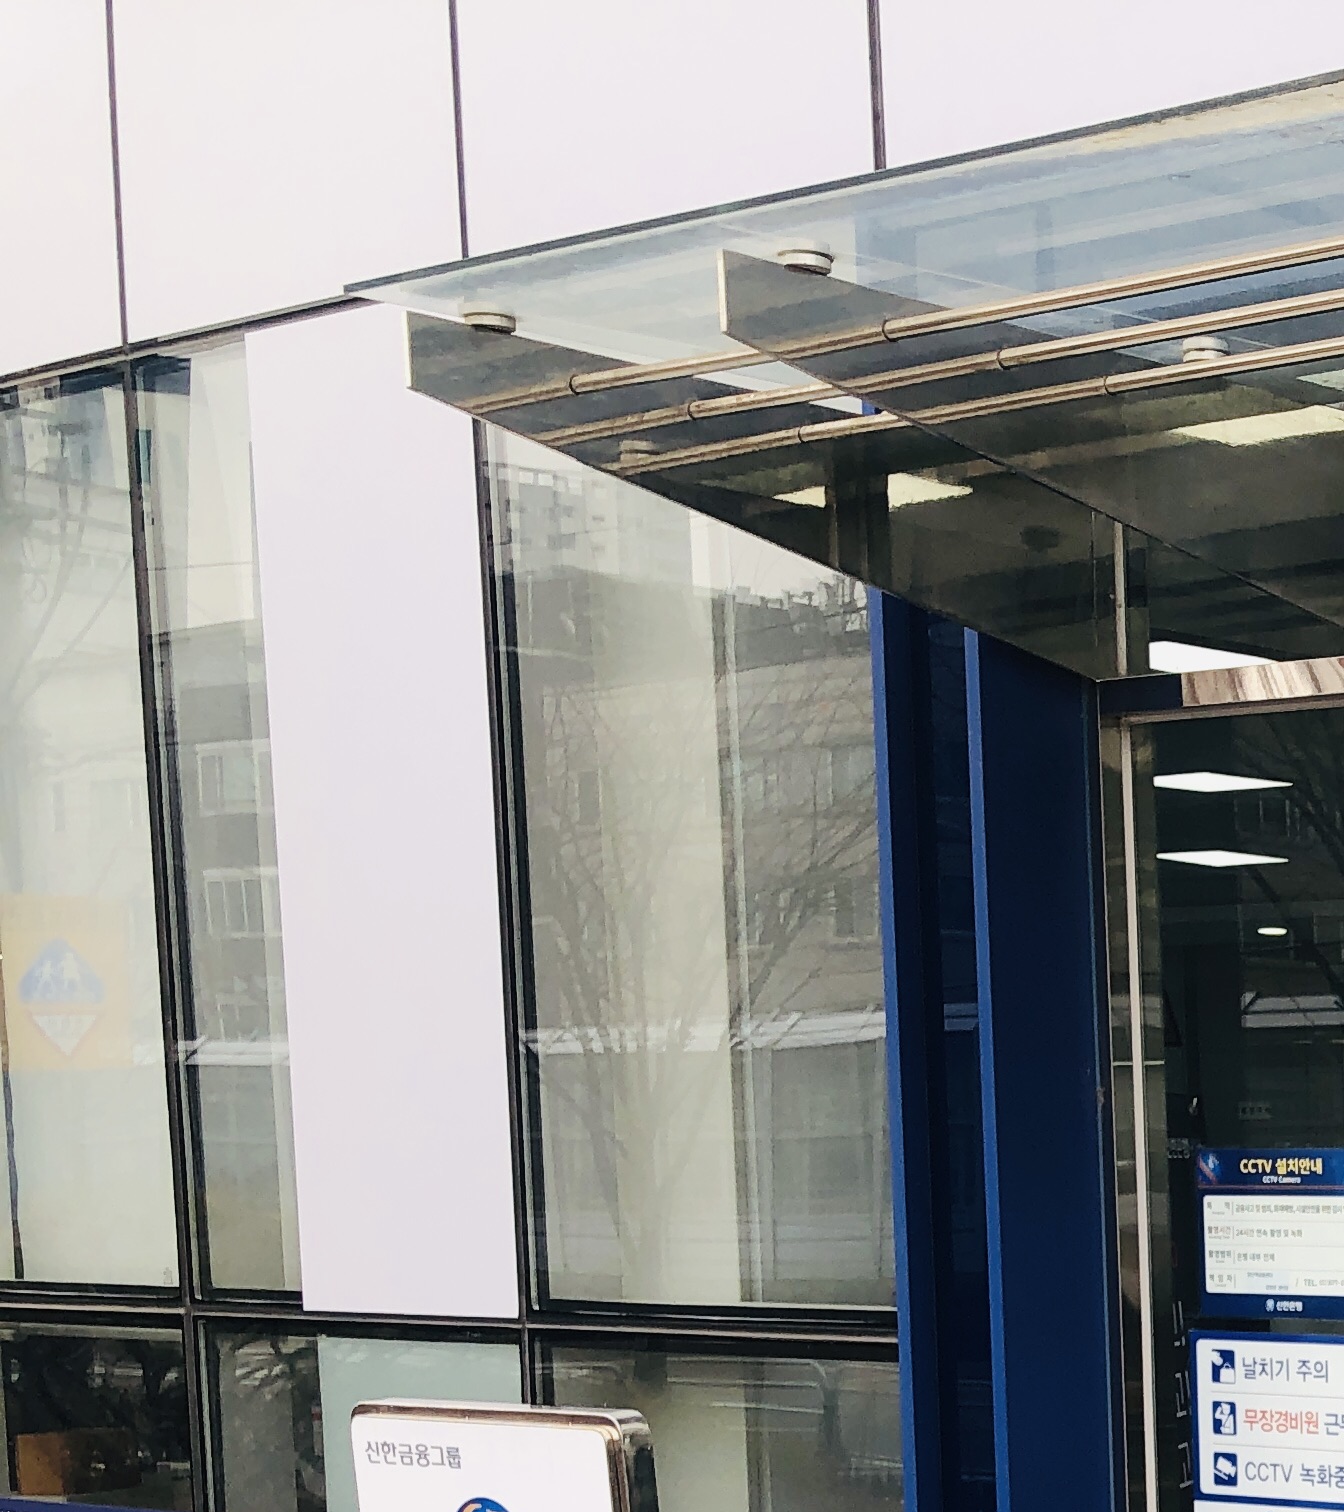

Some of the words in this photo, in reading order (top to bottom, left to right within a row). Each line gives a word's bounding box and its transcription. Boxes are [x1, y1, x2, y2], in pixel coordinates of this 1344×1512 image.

[1240, 1158, 1272, 1174] CCTV
[1275, 1158, 1323, 1175] 설치안내
[1242, 1356, 1290, 1382] 날치기
[1296, 1359, 1330, 1384] 주의
[1243, 1408, 1320, 1435] 무장경비원
[365, 1440, 462, 1469] 신한금융그룹
[1244, 1461, 1294, 1483] CCTV
